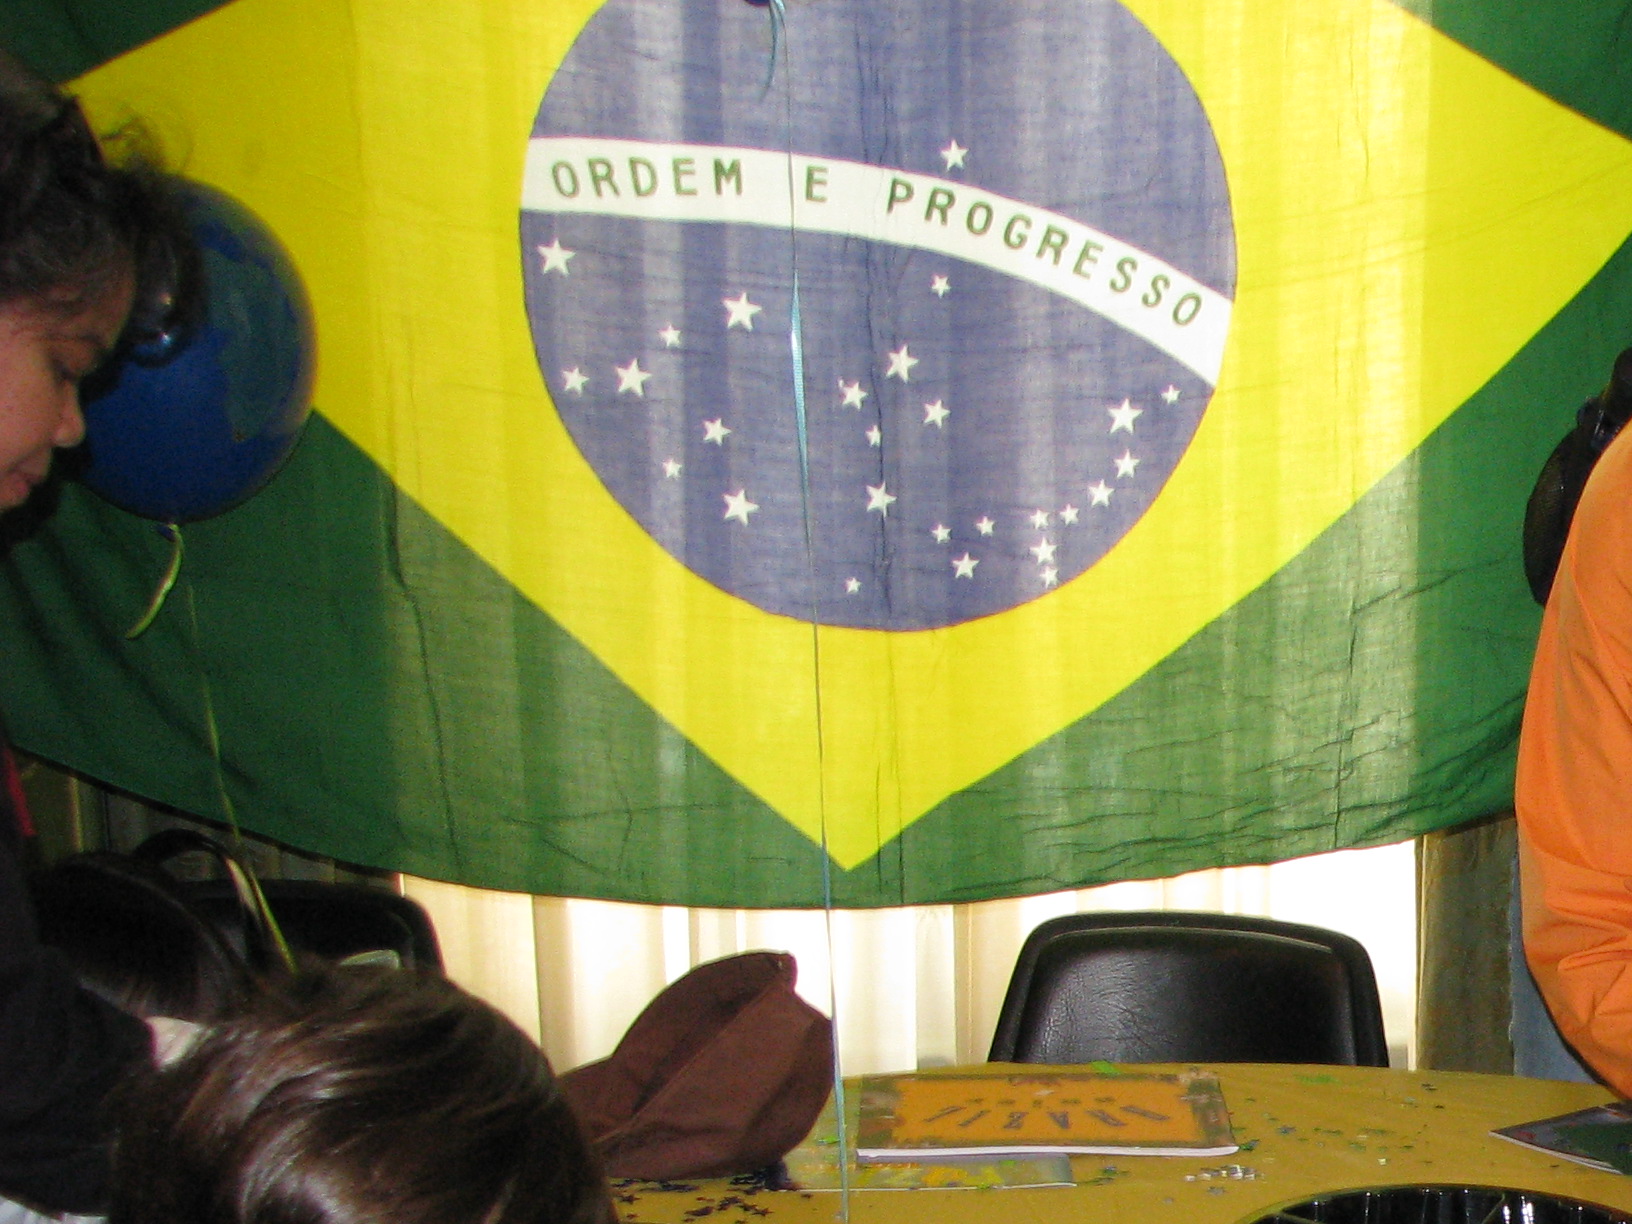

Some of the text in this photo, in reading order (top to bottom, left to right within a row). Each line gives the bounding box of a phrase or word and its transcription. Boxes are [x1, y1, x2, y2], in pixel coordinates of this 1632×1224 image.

[551, 157, 1204, 328] ORDEM E PROGRESSO
